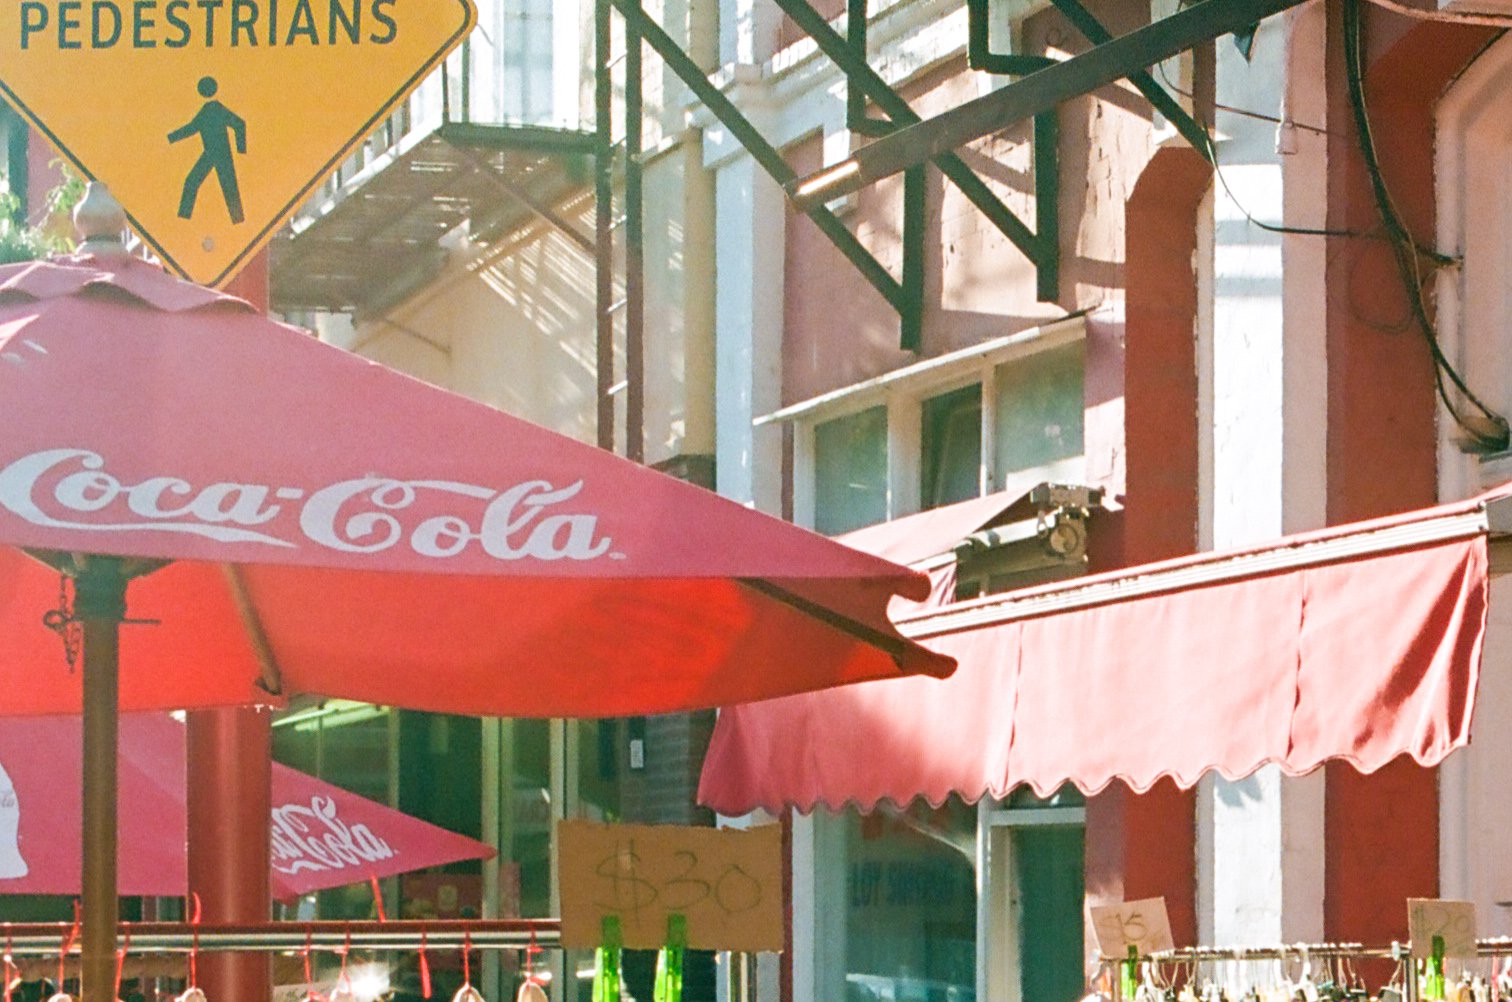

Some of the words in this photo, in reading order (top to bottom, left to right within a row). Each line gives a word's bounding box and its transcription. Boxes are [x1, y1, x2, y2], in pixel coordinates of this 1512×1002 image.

[20, 0, 398, 50] PEDESTRIANS
[0, 448, 611, 560] Coca-Cola
[595, 838, 762, 928] $30
